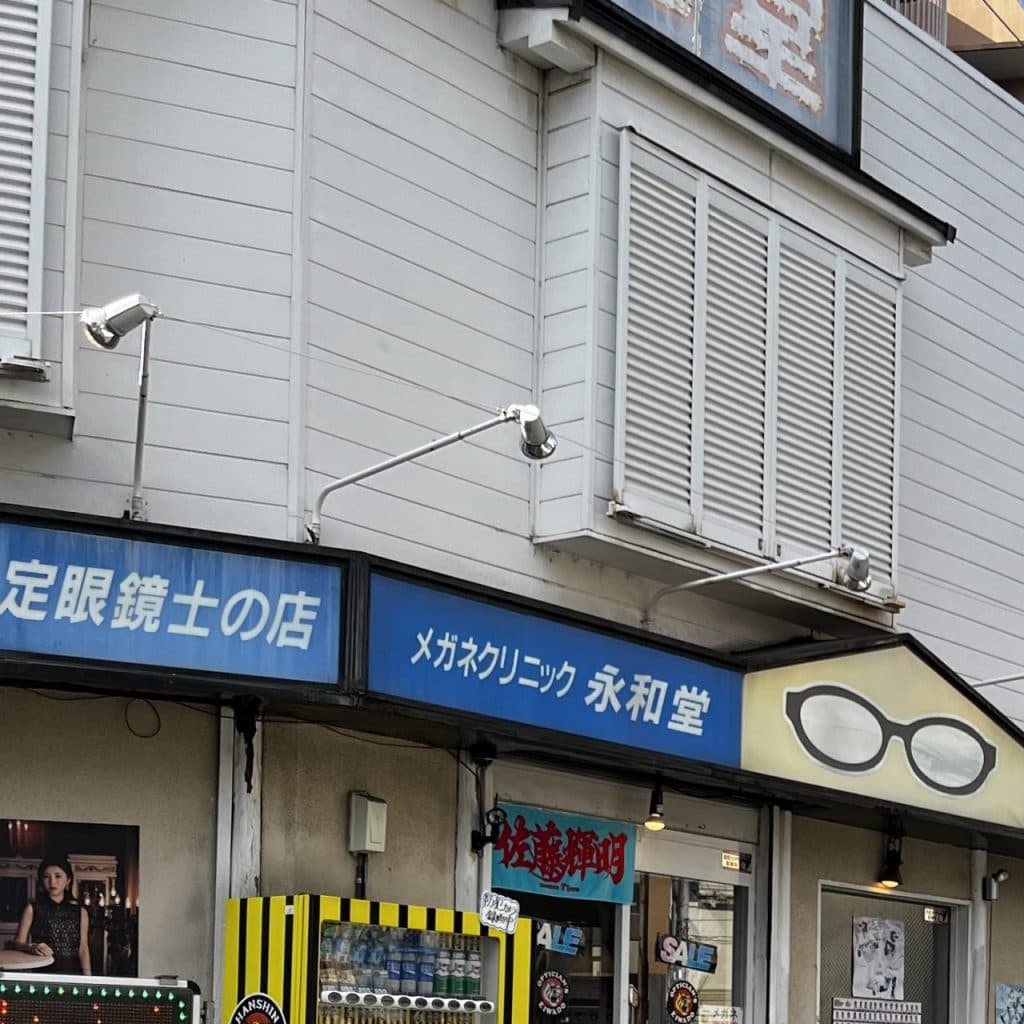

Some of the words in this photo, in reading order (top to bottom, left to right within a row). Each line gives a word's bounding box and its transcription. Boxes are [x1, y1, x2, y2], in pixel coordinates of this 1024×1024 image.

[0, 558, 321, 650] 定眼鏡士の店
[409, 627, 577, 698] メガネクリニック
[584, 663, 711, 736] 永和堂
[536, 921, 583, 956] ALE
[660, 936, 716, 971] SALE
[234, 999, 281, 1024] HANSHIN
